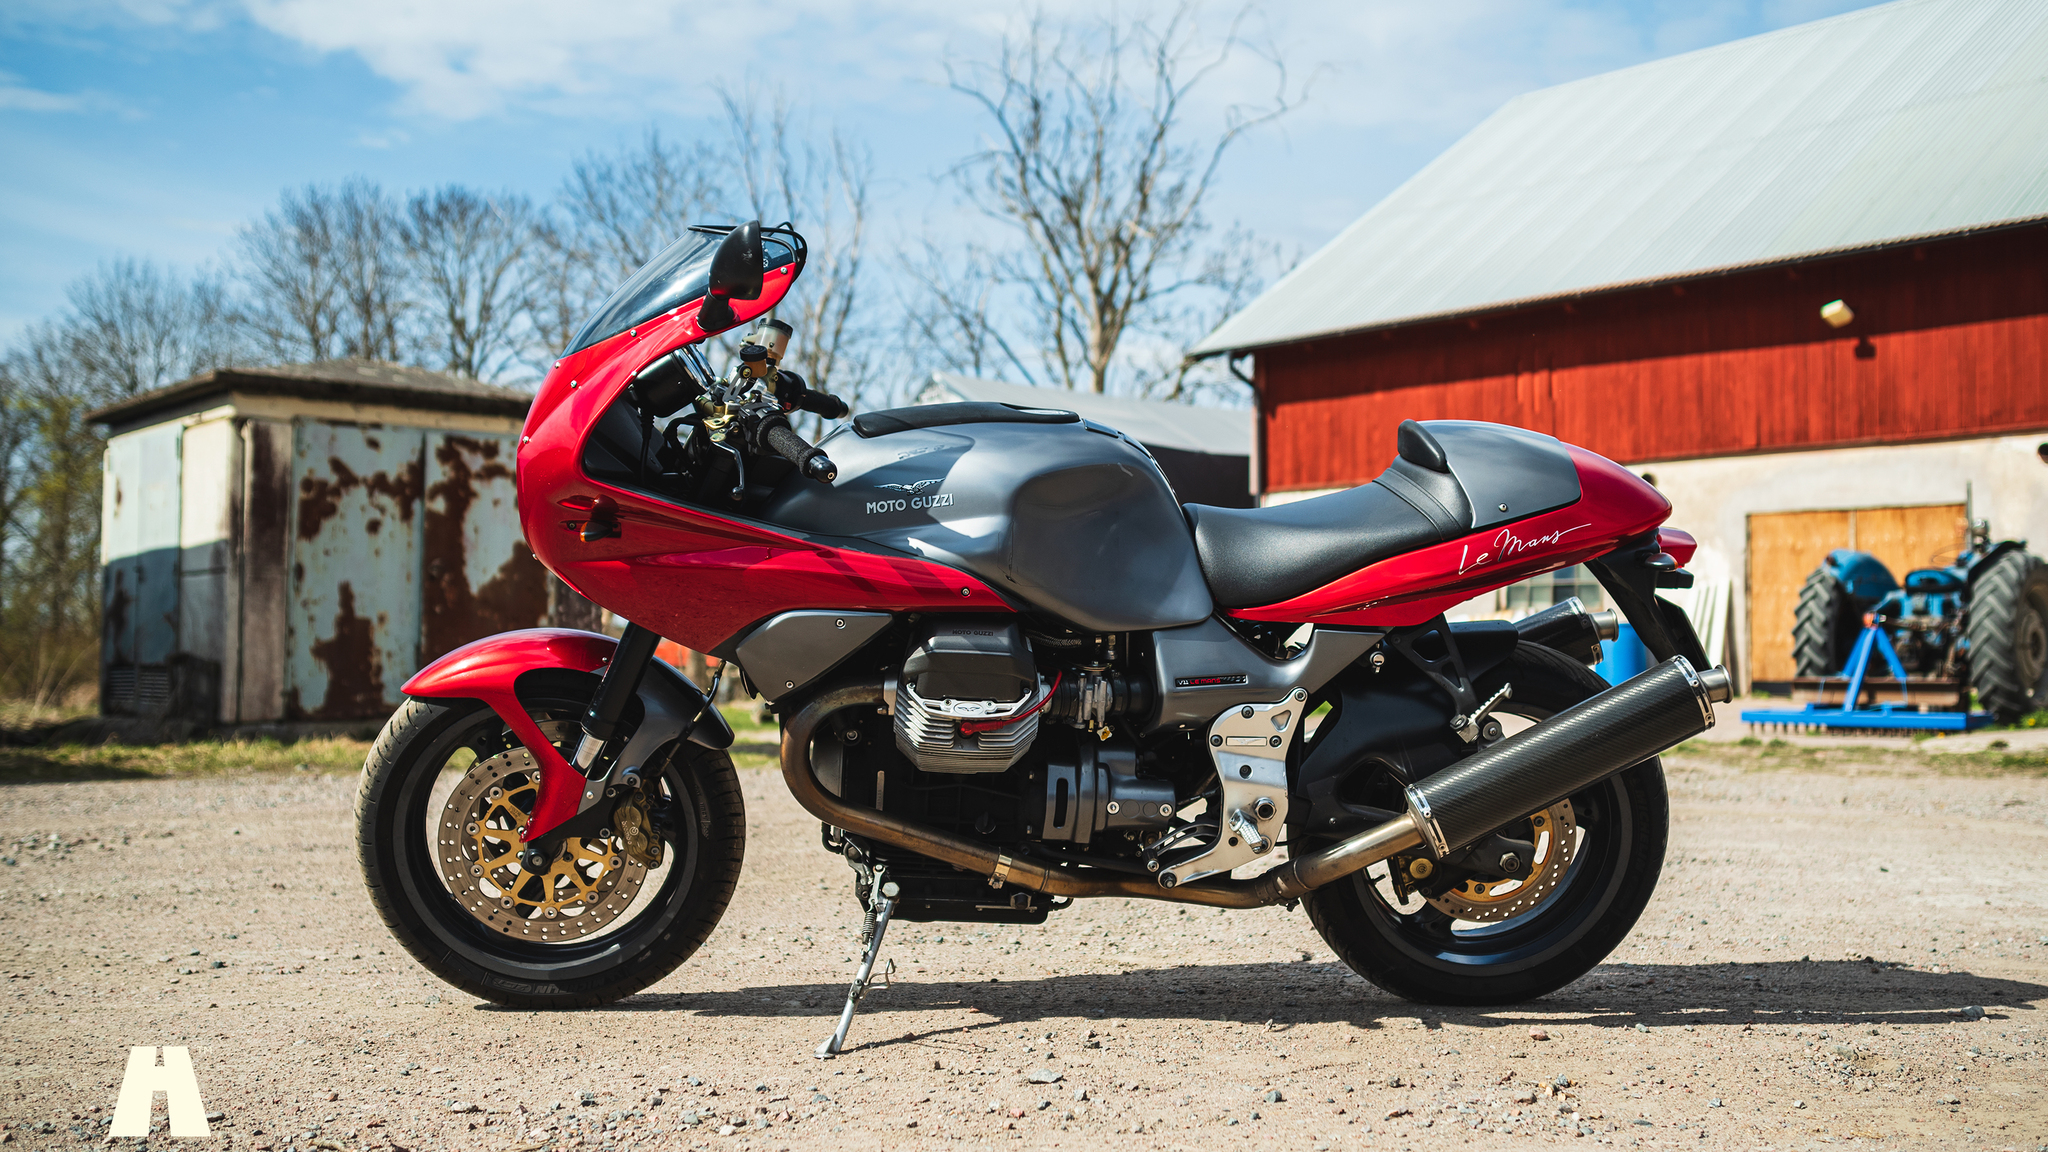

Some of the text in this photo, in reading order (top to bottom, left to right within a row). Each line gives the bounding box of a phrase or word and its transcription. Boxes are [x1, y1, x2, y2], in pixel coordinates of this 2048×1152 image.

[866, 493, 955, 515] MOTO GUZZI
[1458, 523, 1592, 575] Le Mans
